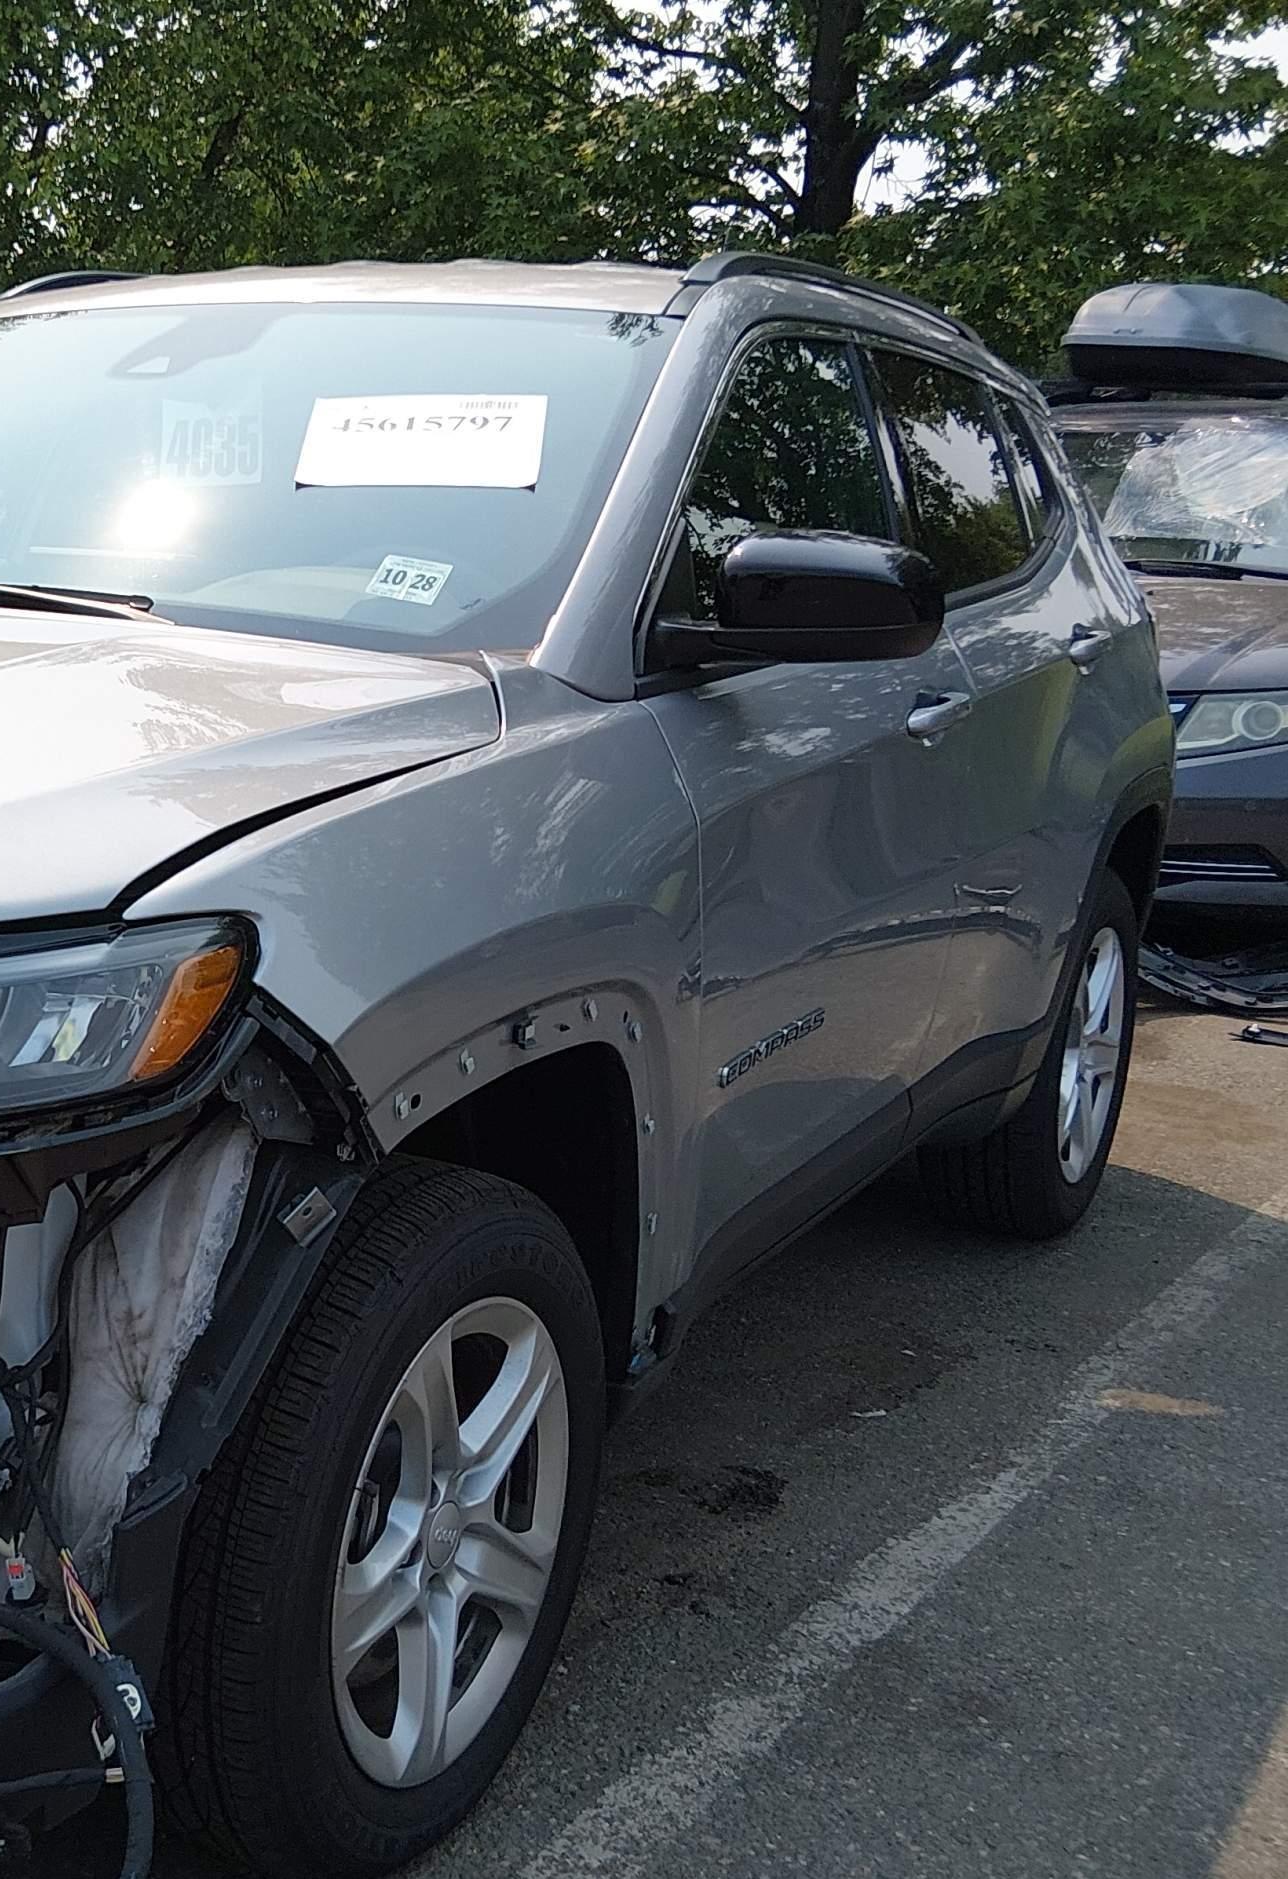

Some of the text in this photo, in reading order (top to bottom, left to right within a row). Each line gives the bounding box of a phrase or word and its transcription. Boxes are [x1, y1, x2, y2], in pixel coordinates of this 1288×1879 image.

[166, 415, 259, 478] 4035
[379, 568, 437, 591] 10 28
[718, 1008, 826, 1088] COMPASS
